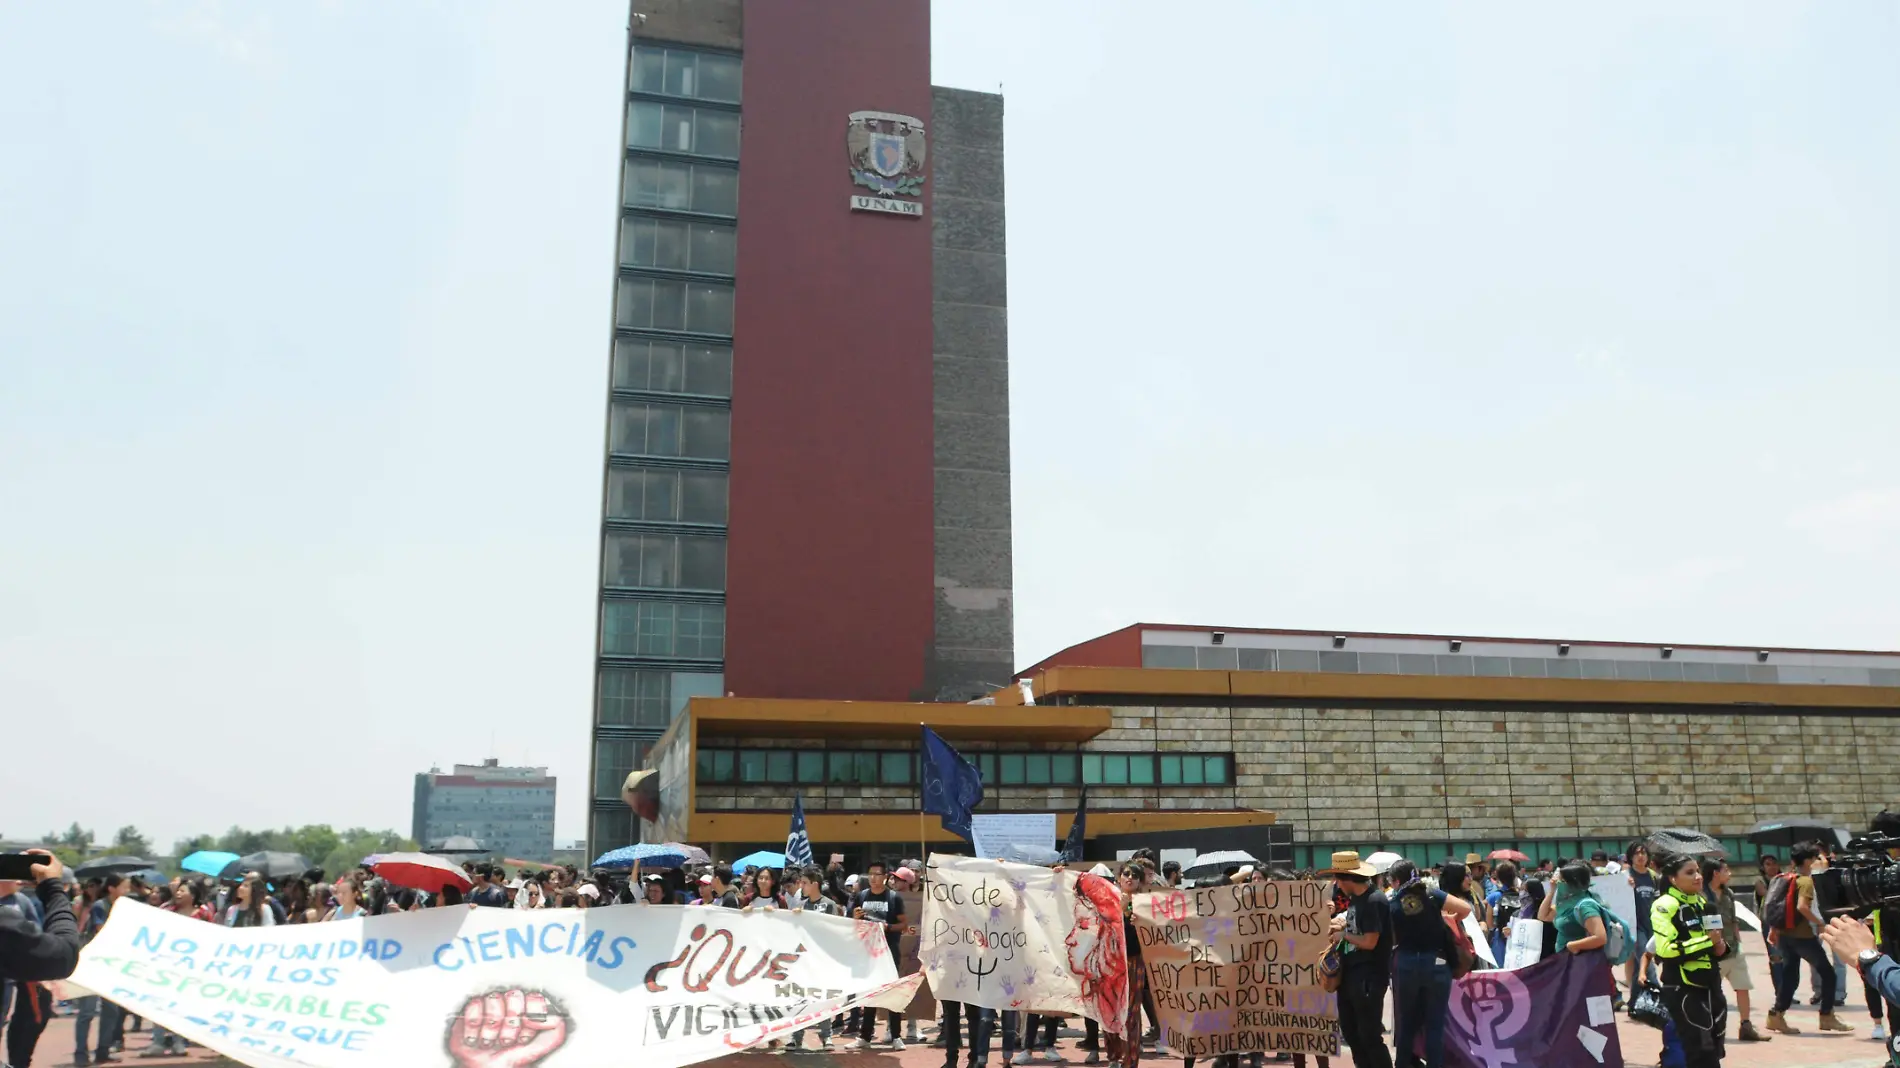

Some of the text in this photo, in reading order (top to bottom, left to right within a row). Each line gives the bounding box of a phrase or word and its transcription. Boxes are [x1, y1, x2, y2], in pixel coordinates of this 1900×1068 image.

[858, 199, 917, 213] UNAM
[972, 878, 1003, 908] de
[1151, 882, 1327, 922] NO ES SOLO HOY
[131, 926, 403, 961] NO IMPUNIDAD
[934, 918, 1027, 961] Psicología
[1139, 912, 1321, 947] DIARIO ESTAMOS
[433, 923, 637, 971] CIENCIAS
[1190, 939, 1278, 964] DE LUTO
[267, 965, 341, 987] LOS
[1151, 962, 1187, 990] HOY
[1194, 965, 1226, 988] ME
[1265, 987, 1286, 1007] EN
[1209, 1030, 1267, 1053] FUERON
[1267, 1031, 1291, 1050] LAS
